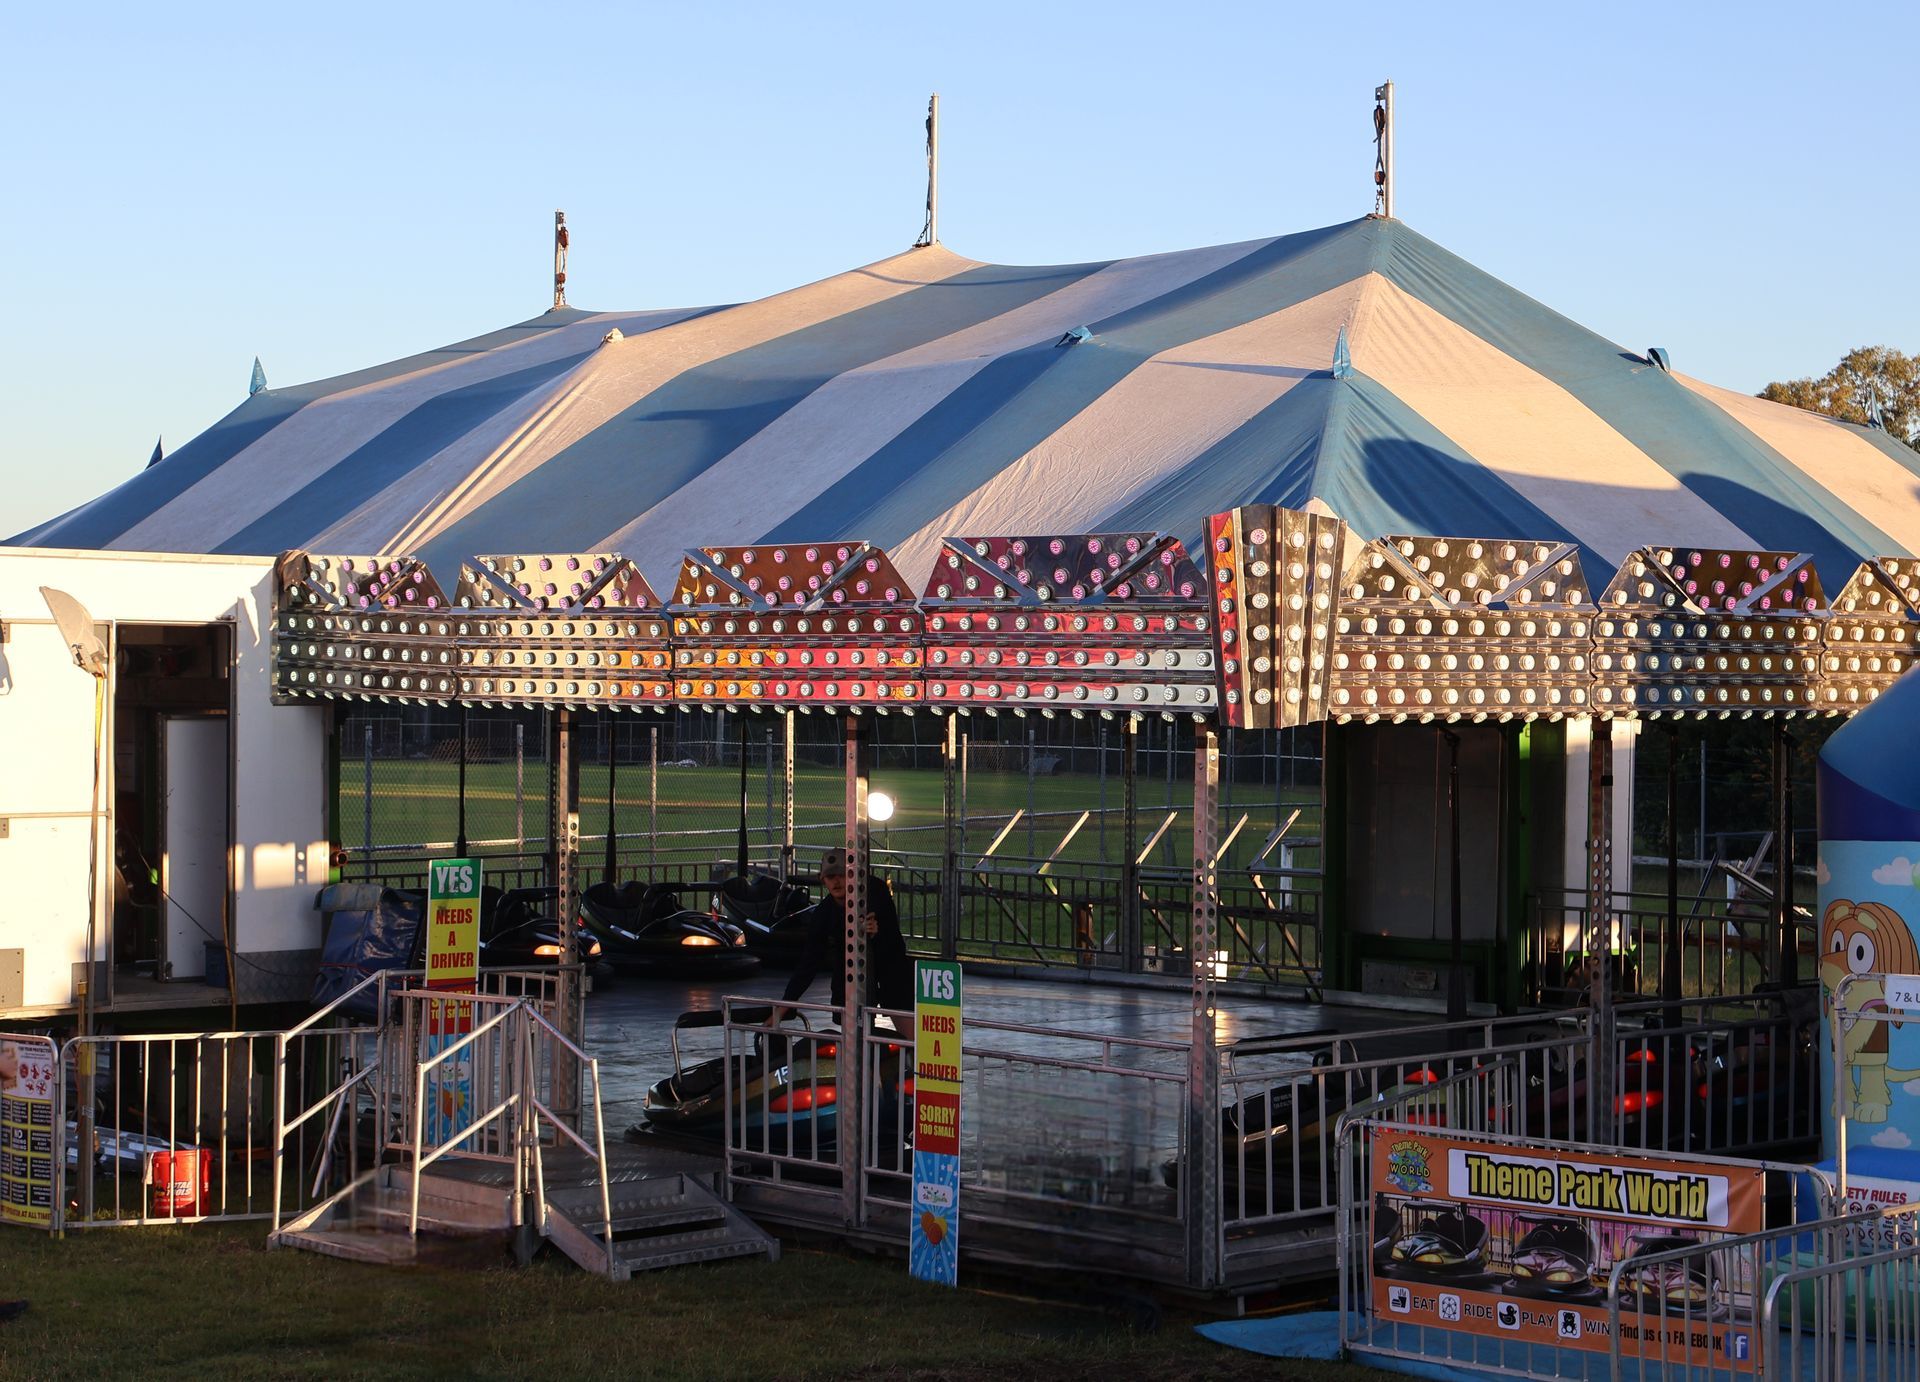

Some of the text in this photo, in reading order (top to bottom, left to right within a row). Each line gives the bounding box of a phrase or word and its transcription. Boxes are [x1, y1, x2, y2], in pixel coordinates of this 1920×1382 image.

[435, 866, 473, 893] YES
[435, 908, 473, 925] NEEDS
[448, 930, 456, 947] A
[431, 952, 474, 970] DRIVER
[920, 968, 955, 1000] YES
[1895, 991, 1902, 1002] 7
[1903, 992, 1913, 1003] &
[922, 1014, 956, 1035] NEEDS
[933, 1039, 942, 1057] A
[774, 1065, 789, 1086] 15
[919, 1062, 958, 1081] DRIVER
[919, 1104, 956, 1125] SORRY
[919, 1122, 956, 1138] TOO SMALL
[1390, 1163, 1430, 1178] WORLD
[1465, 1154, 1710, 1223] Theme Park World
[1870, 1189, 1907, 1204] RULES
[1413, 1297, 1610, 1335] EAT RIDE PLAY WIN
[1619, 1323, 1639, 1340] Find
[1644, 1328, 1655, 1341] us
